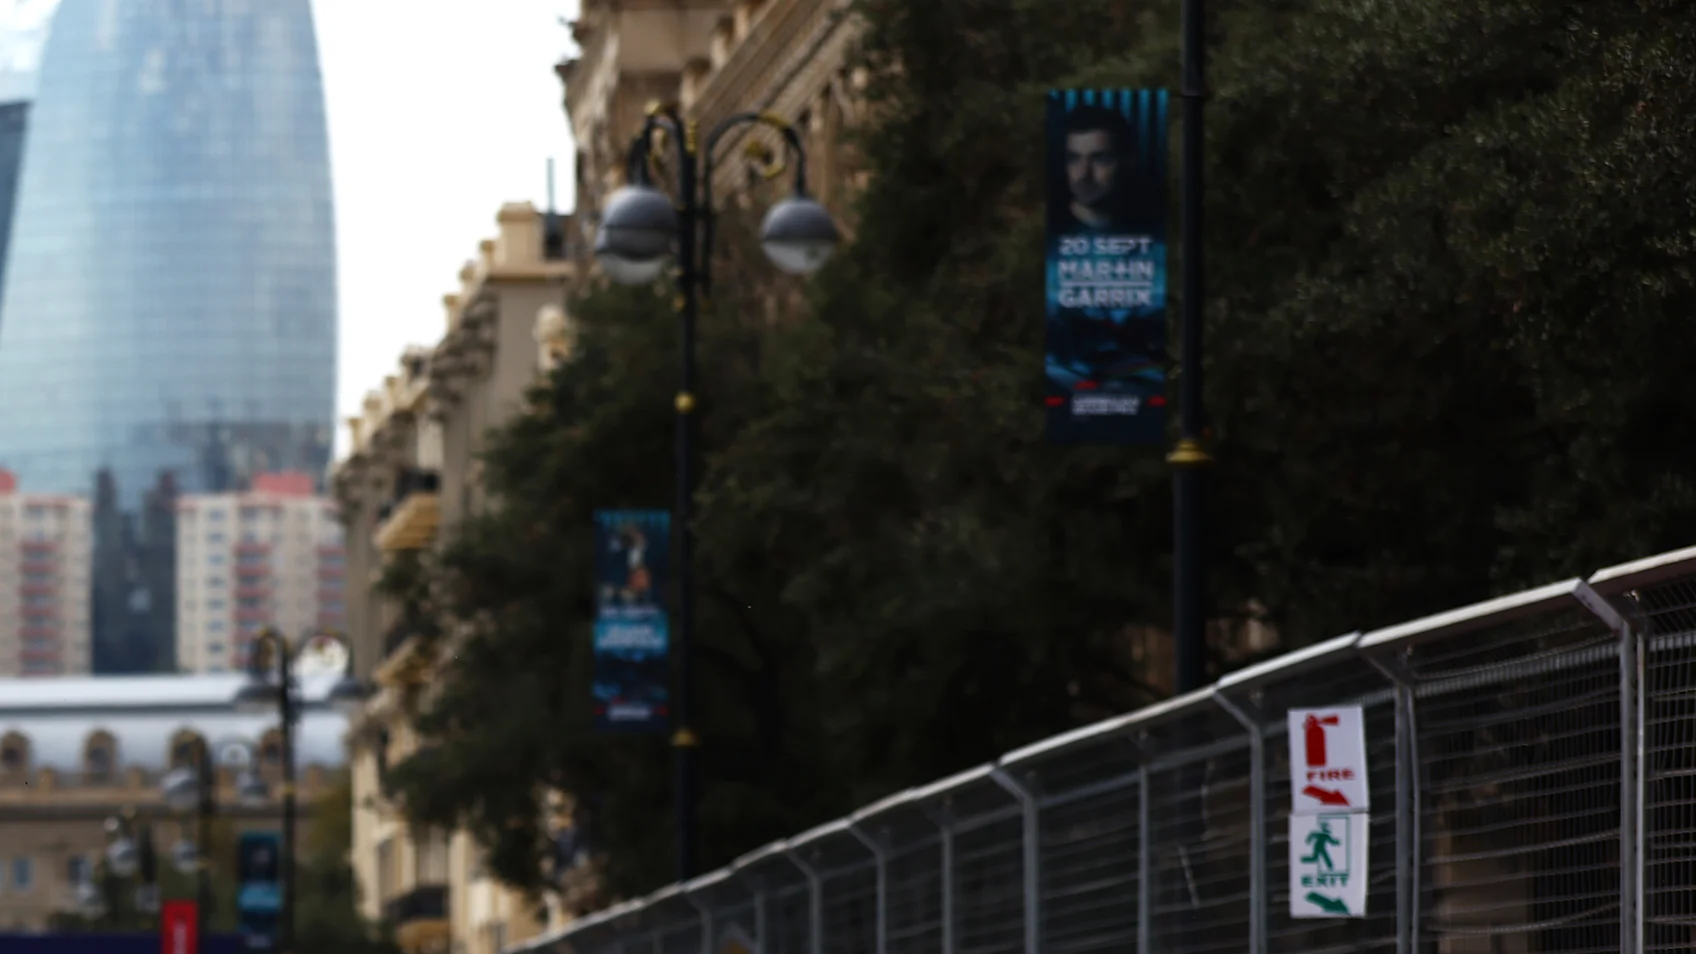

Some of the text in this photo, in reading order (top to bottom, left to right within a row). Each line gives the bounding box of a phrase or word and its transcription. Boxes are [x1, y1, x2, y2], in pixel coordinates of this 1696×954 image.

[1059, 236, 1152, 255] 20 SEPT
[1305, 768, 1356, 781] FIRE
[1300, 876, 1349, 887] EXIT
